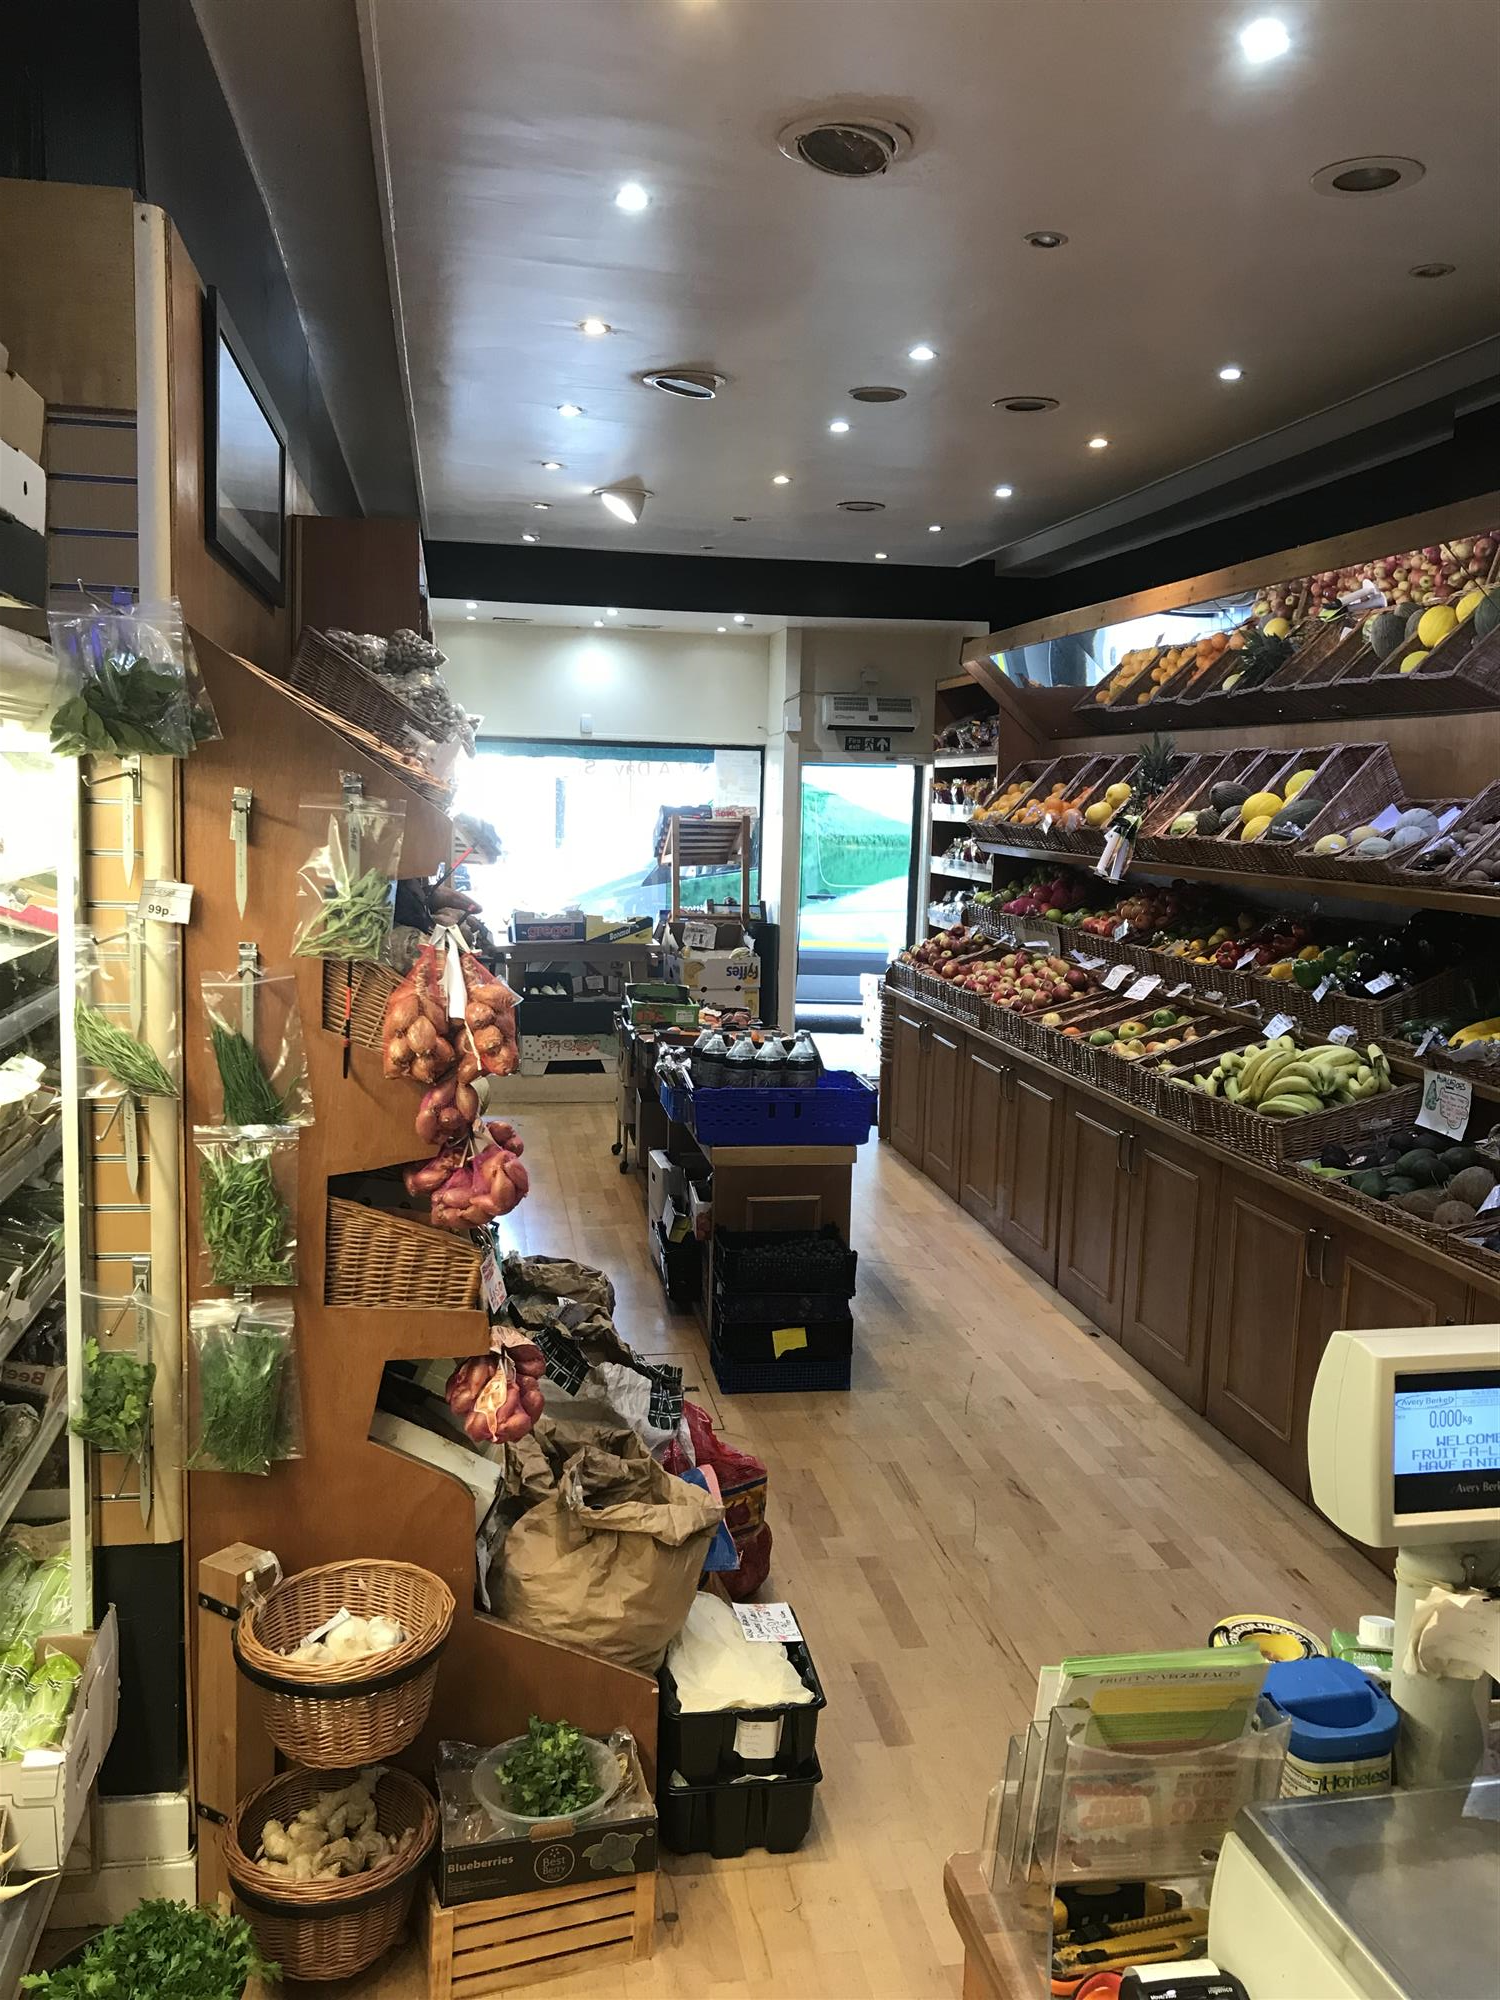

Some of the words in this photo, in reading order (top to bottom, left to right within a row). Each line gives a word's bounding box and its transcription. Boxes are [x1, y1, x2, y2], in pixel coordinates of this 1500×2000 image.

[148, 904, 169, 917] 99p
[1456, 1483, 1480, 1493] Avery
[447, 1856, 514, 1874] Blueberries
[543, 1856, 566, 1868] Best
[543, 1866, 566, 1877] Berry
